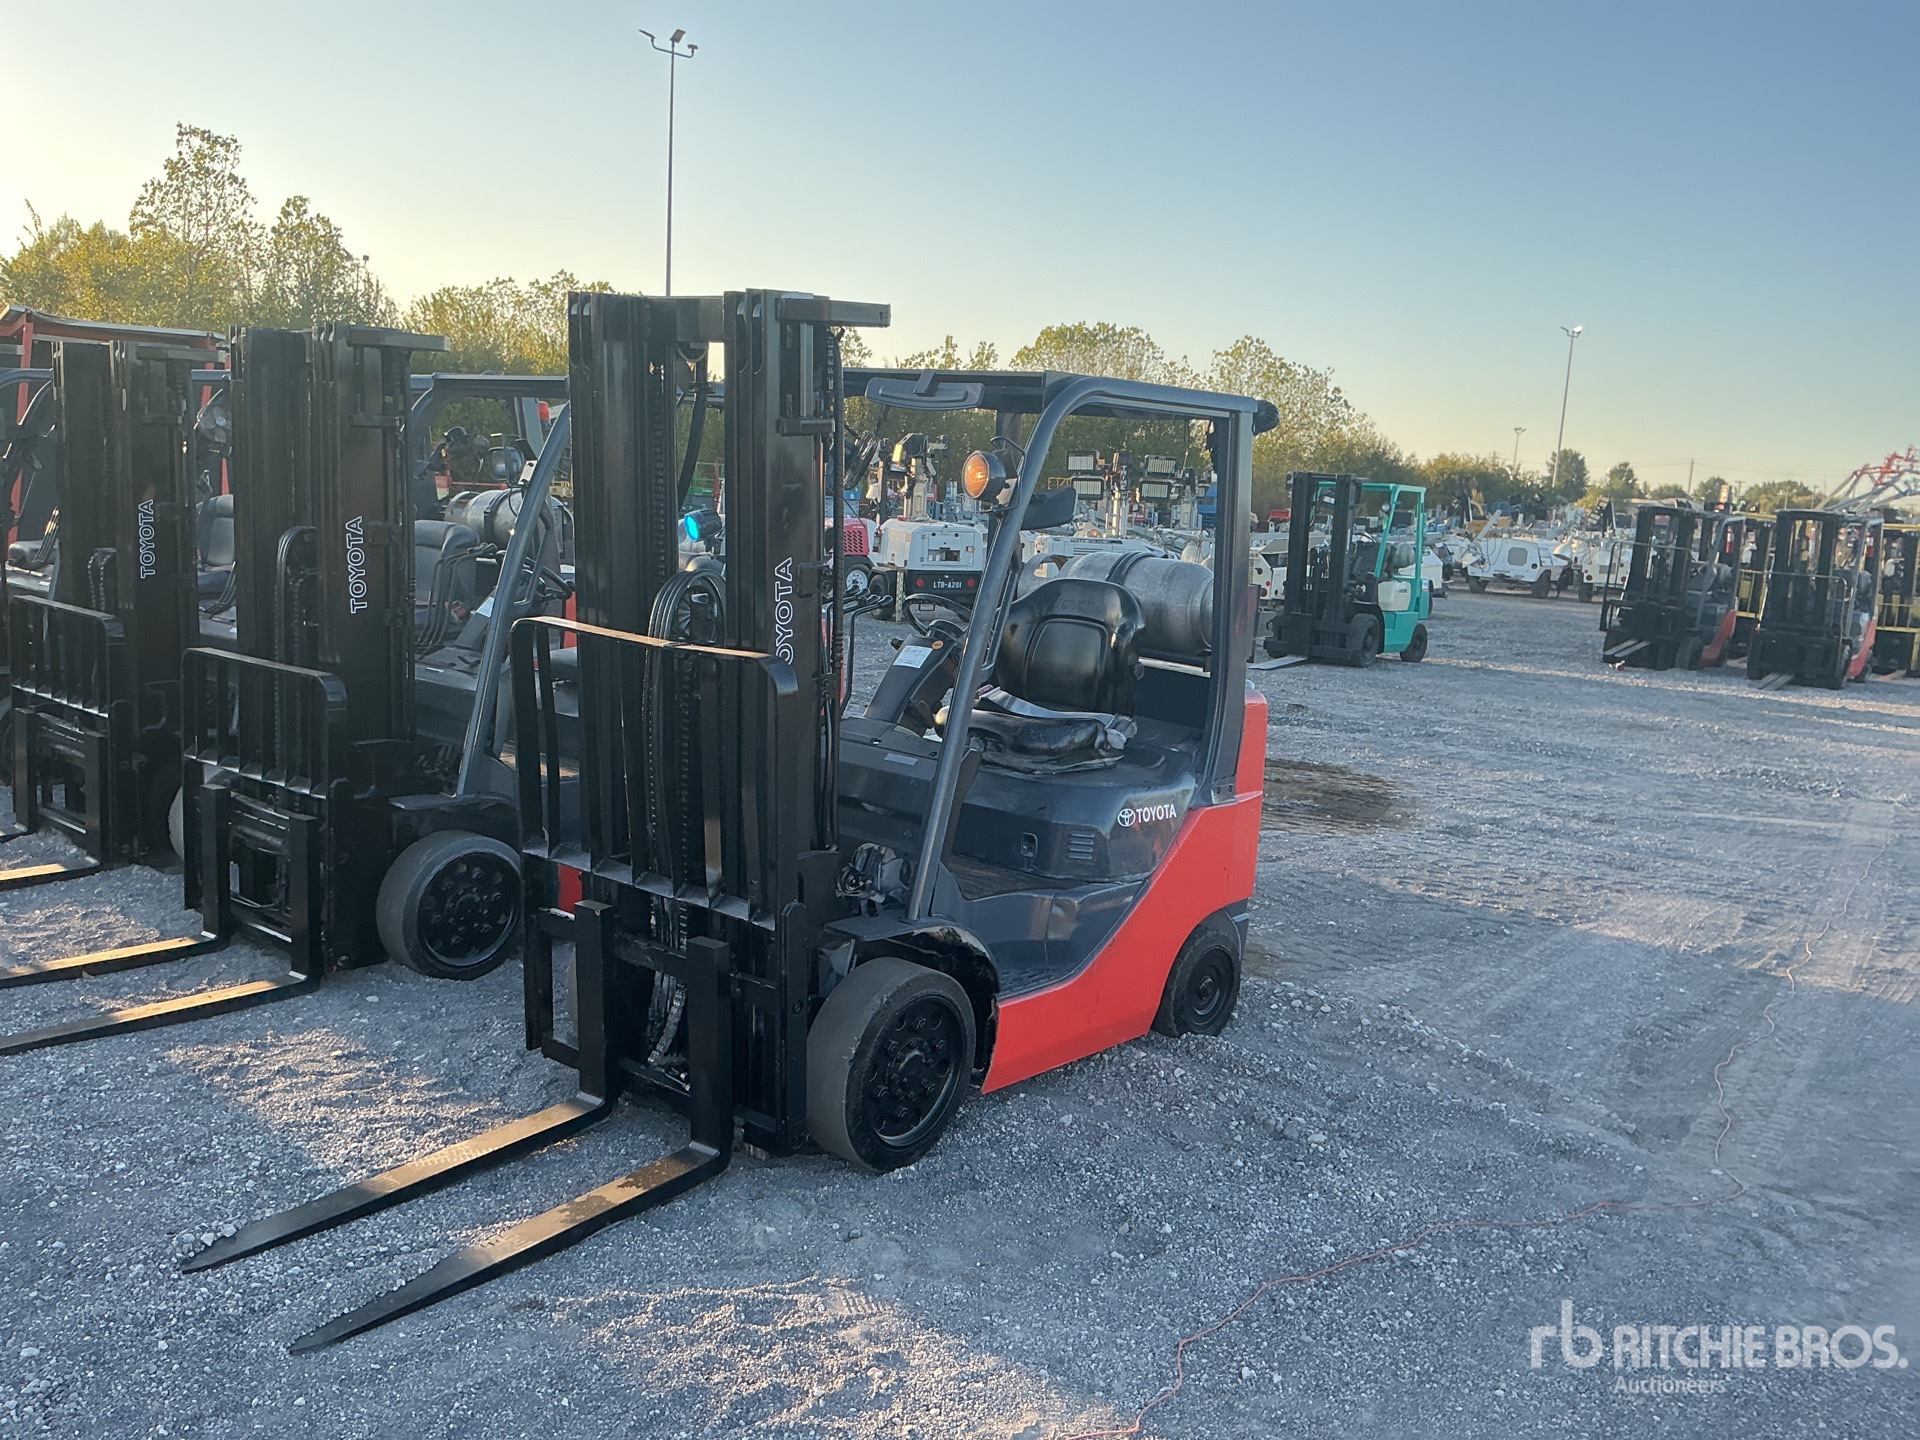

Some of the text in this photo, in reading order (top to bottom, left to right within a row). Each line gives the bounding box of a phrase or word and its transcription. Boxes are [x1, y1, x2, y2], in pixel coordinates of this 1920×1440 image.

[138, 499, 156, 579] TOYOTA
[345, 516, 368, 614] TOYOTA
[774, 557, 794, 665] OYOTA
[1136, 804, 1177, 824] TOYOTA
